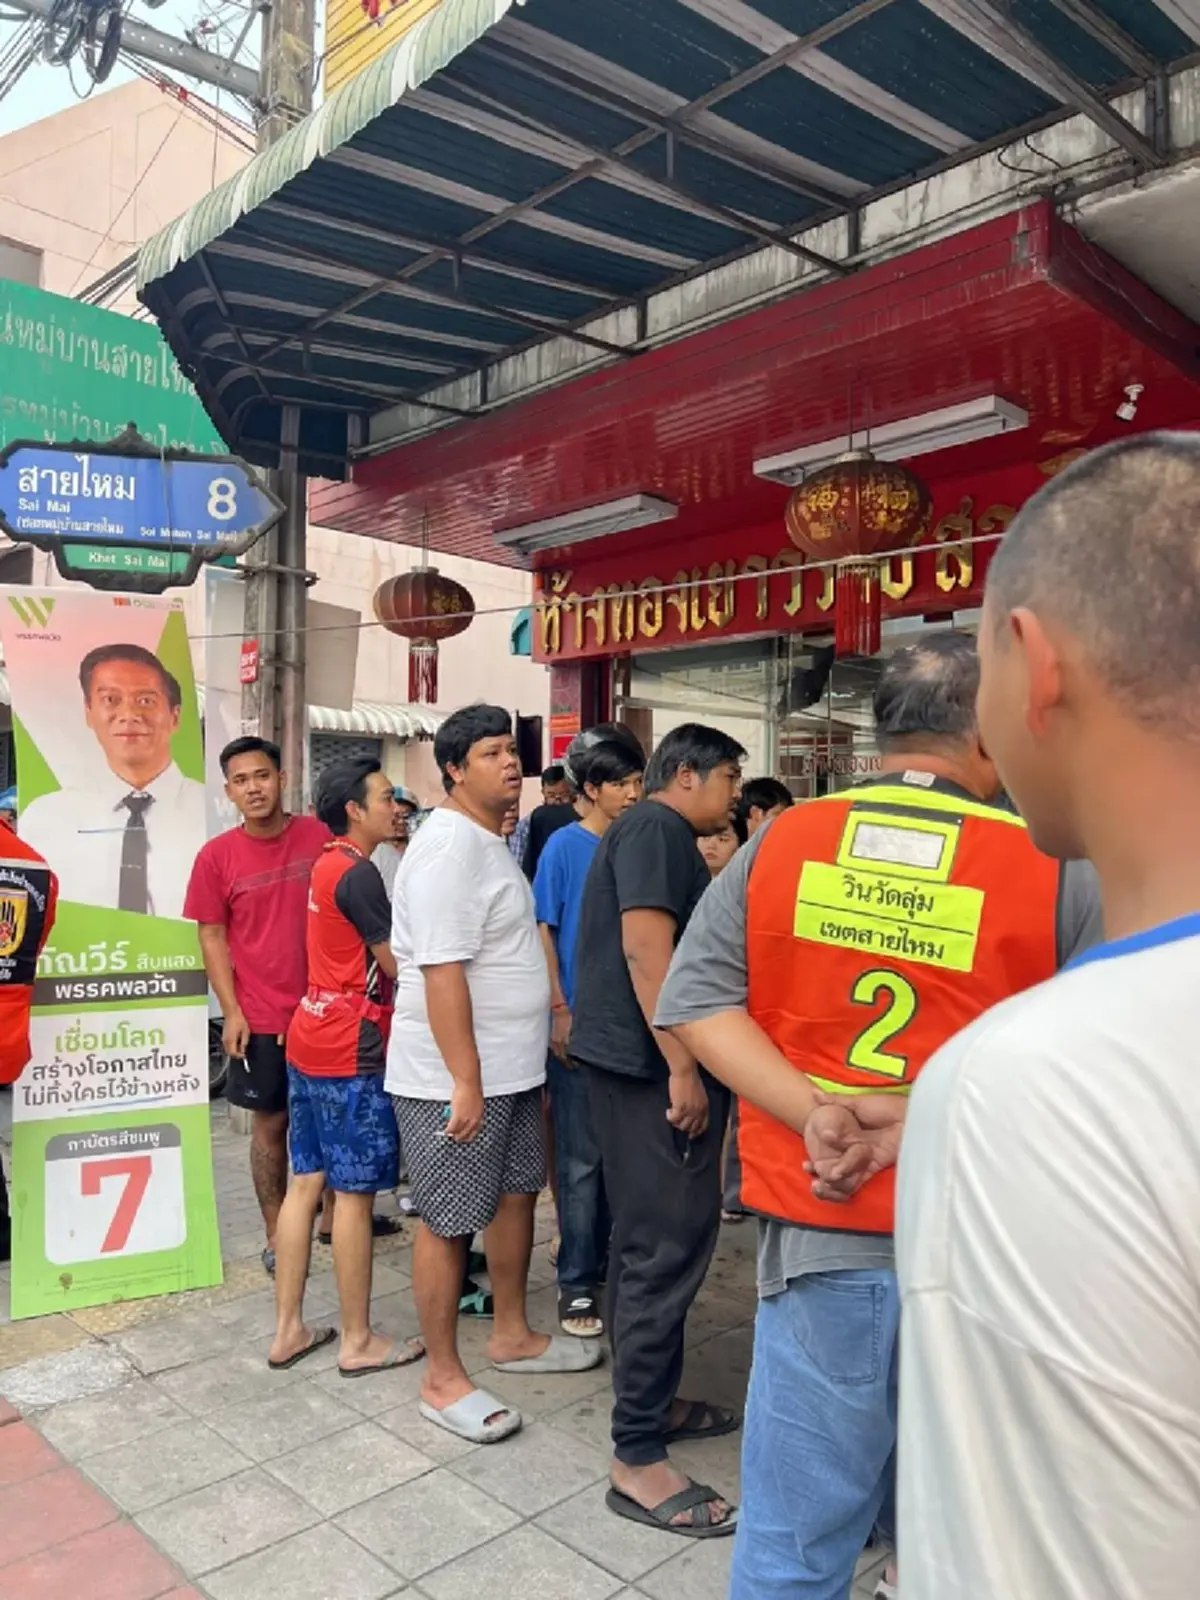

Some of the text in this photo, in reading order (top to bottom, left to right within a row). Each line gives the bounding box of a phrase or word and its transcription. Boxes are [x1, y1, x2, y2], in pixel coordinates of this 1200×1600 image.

[19, 453, 135, 500] สายไหม
[18, 497, 71, 513] Sai Mai
[208, 478, 237, 520] 8
[139, 525, 156, 537] Soi
[196, 528, 212, 540] Sai
[88, 551, 169, 568] Khet Sai Mai
[842, 873, 935, 919] วินวัดลุ่ม
[819, 921, 945, 959] เขตสายไหม
[136, 953, 196, 971] สืบแสง
[54, 973, 177, 999] พรรคพลวัต
[54, 1018, 166, 1053] เชื่อมโลก
[847, 967, 919, 1080] 2
[32, 1047, 187, 1082] สร้างโอกาสไทย
[21, 1073, 201, 1107] ไม่ทิ้งใครไว้ข้างหลัง
[68, 1129, 161, 1151] กาบัตรสีชมพู
[81, 1155, 152, 1254] 7
